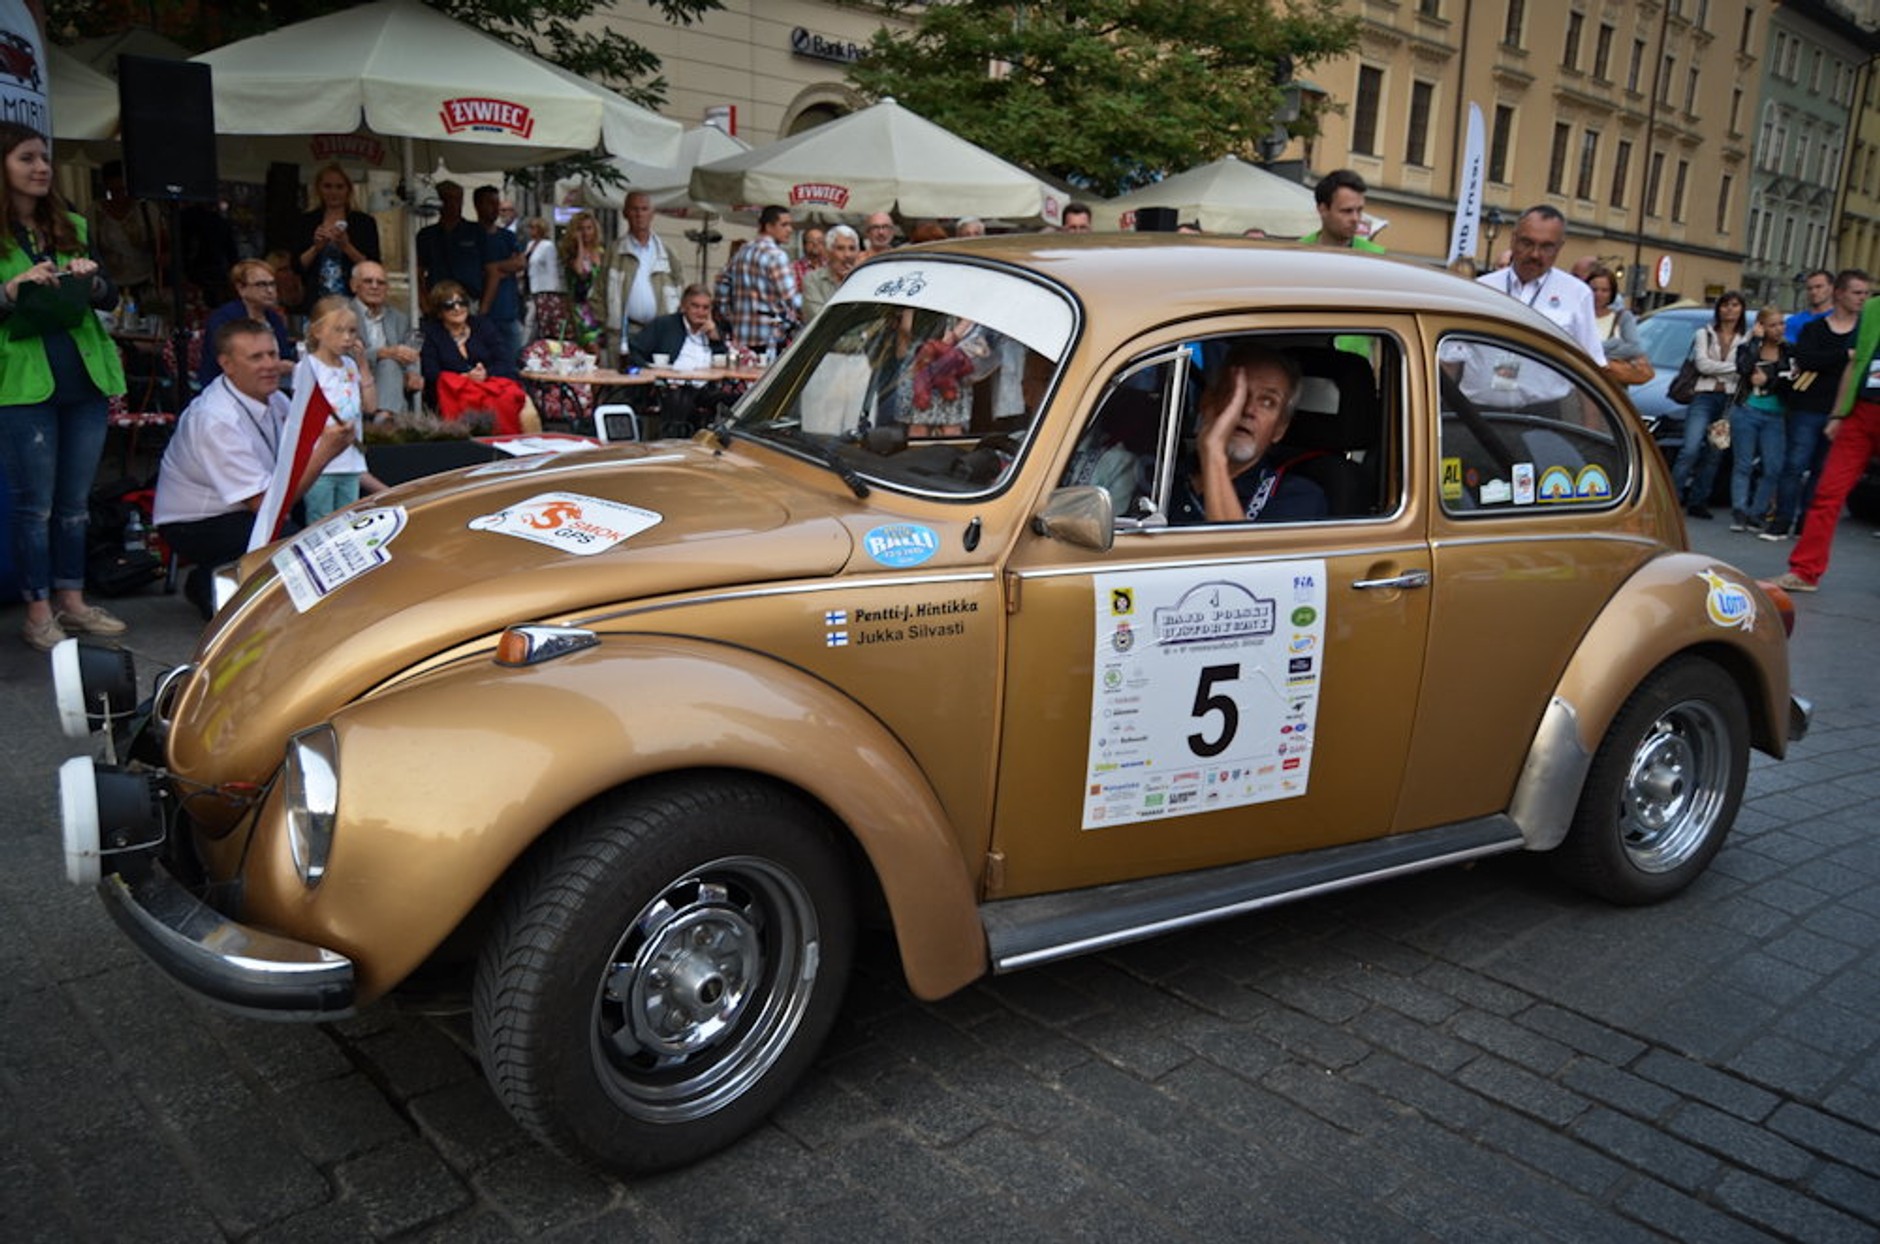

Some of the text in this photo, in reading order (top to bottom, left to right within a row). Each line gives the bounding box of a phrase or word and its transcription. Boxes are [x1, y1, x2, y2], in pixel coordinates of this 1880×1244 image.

[814, 34, 846, 58] Bank
[450, 99, 526, 127] ŻYWIEC
[554, 528, 596, 545] GPS
[567, 520, 626, 541] SMOK
[916, 600, 978, 617] Hintikka
[856, 622, 965, 645] Jukka Silvasti
[1187, 663, 1241, 758] 5
